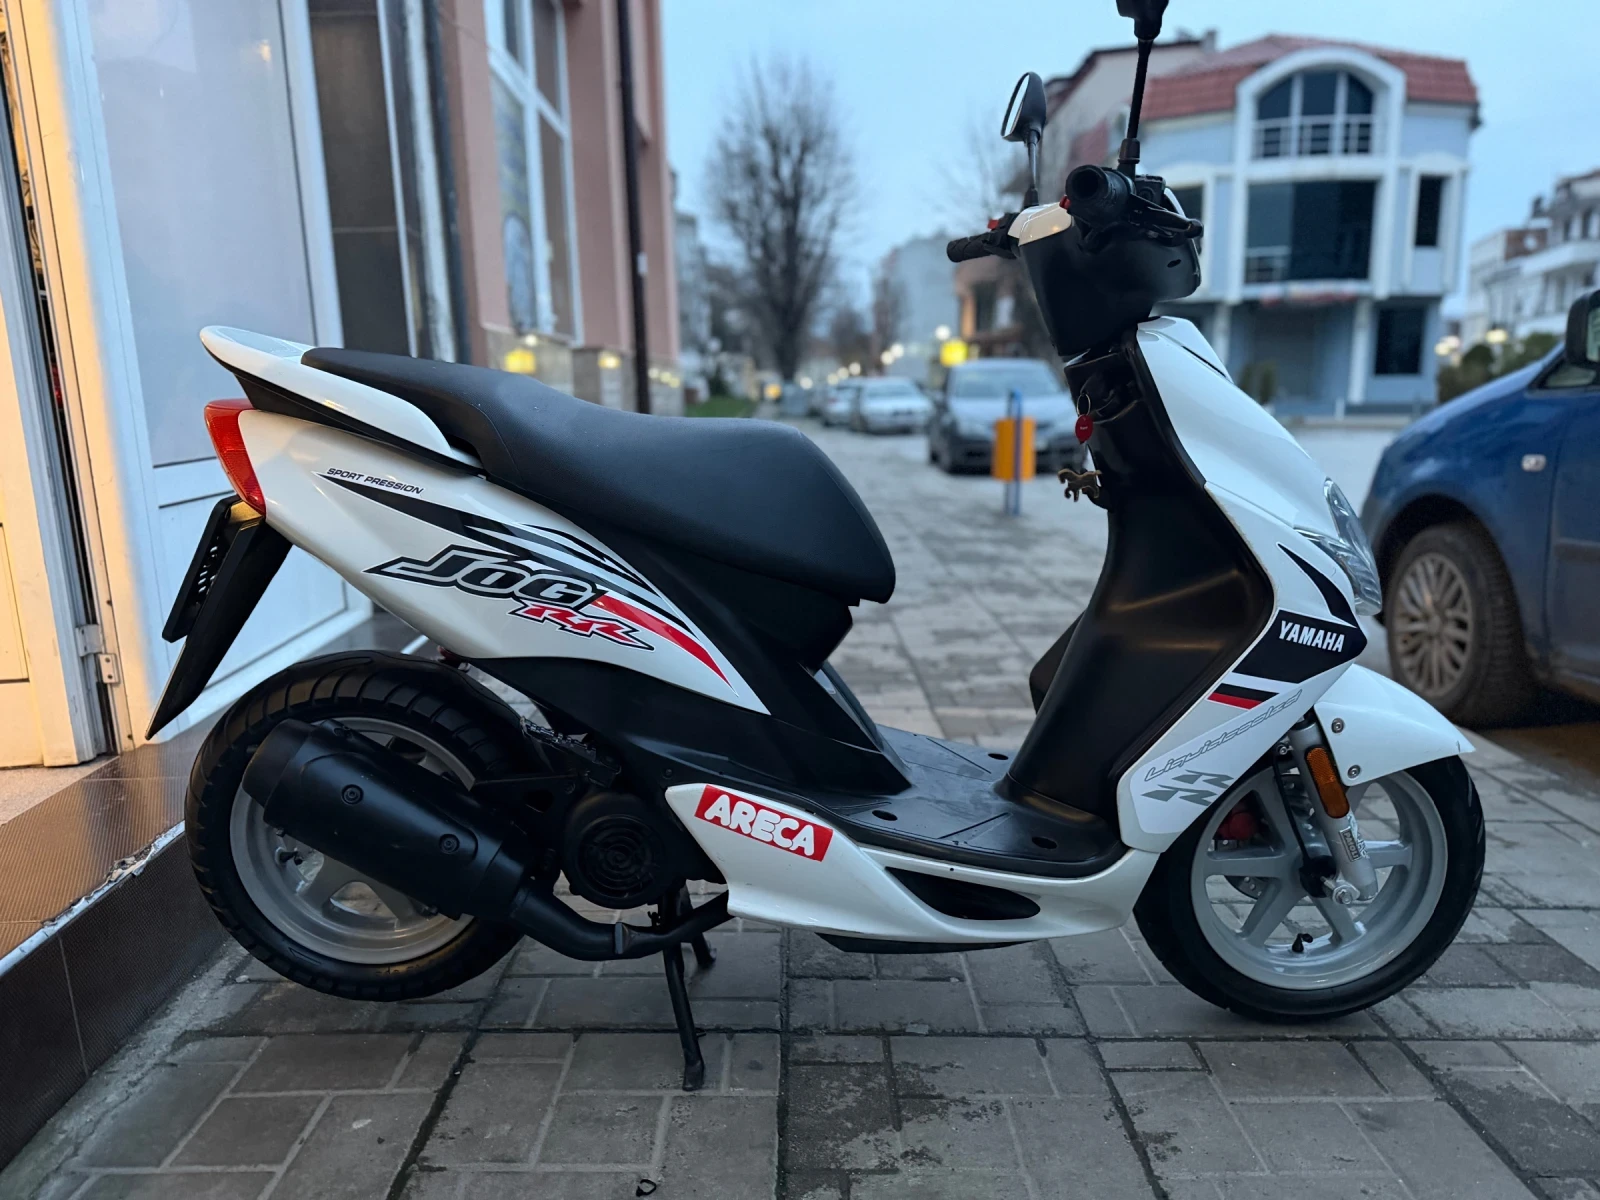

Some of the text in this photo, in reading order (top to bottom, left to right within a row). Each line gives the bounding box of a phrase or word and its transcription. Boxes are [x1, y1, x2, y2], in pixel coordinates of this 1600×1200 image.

[326, 467, 424, 495] SPORT PRESSION
[1279, 620, 1345, 653] YAMAHA
[703, 794, 815, 857] ARECA
